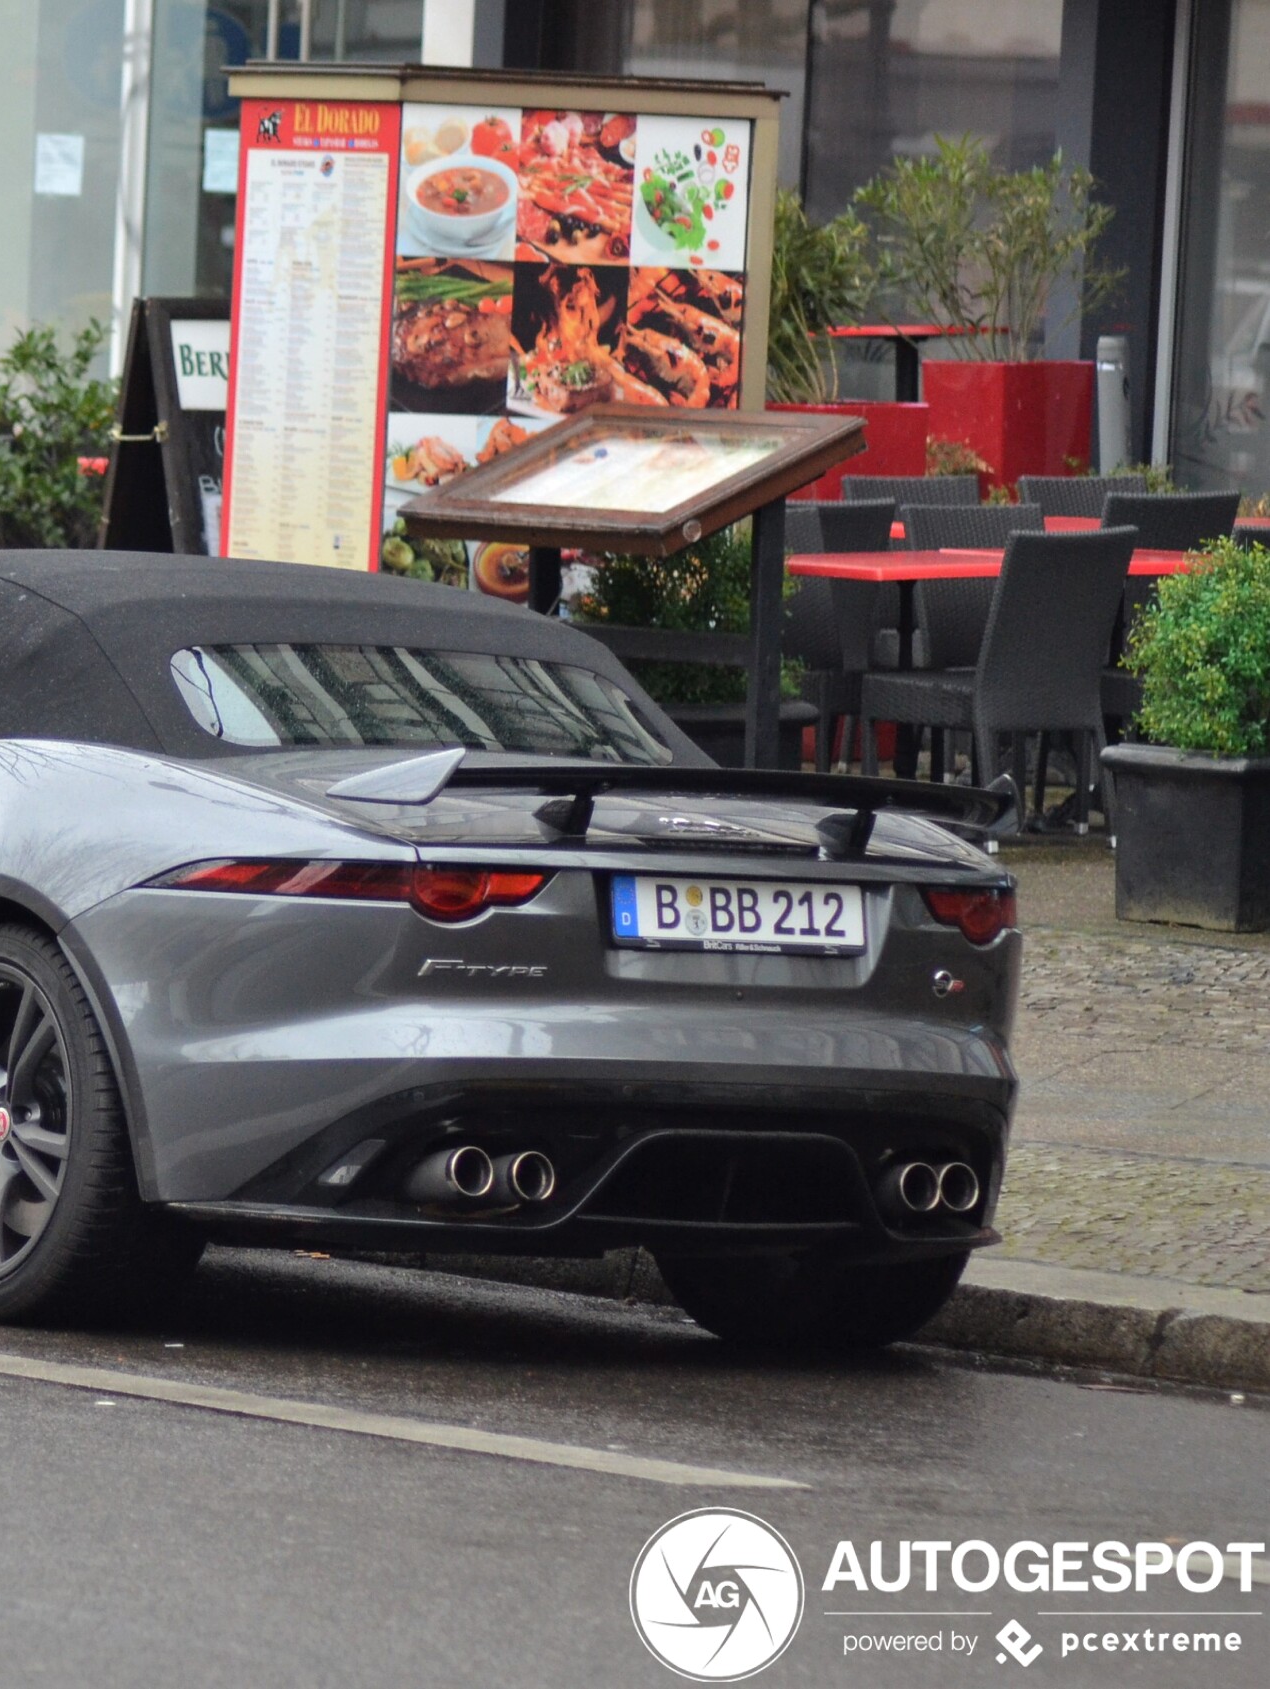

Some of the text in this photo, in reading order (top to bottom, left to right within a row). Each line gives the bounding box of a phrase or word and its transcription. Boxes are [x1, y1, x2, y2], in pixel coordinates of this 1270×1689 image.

[293, 102, 380, 134] EL DORADO
[621, 912, 631, 926] D
[655, 884, 846, 938] B BB 212
[417, 958, 548, 977] F-TYPE
